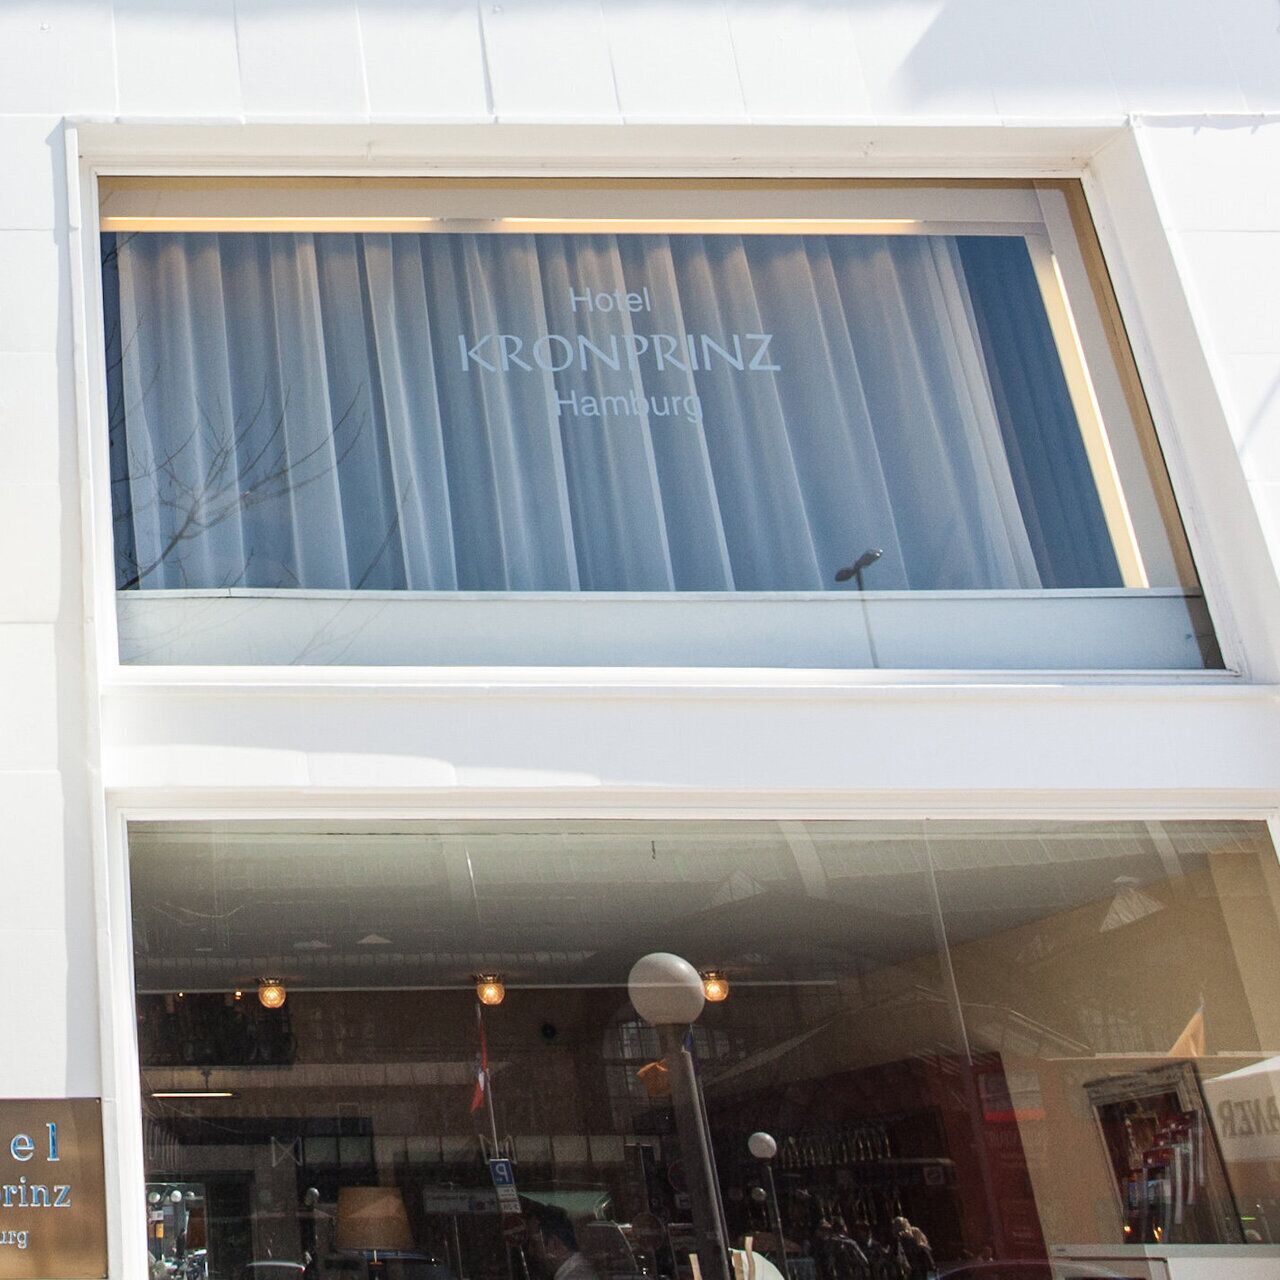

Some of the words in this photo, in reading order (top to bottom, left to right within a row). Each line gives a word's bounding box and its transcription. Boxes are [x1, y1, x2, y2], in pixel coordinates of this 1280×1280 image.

[569, 287, 652, 314] Hotel
[458, 332, 782, 373] KRONPRINZ
[553, 388, 705, 424] Hamburg
